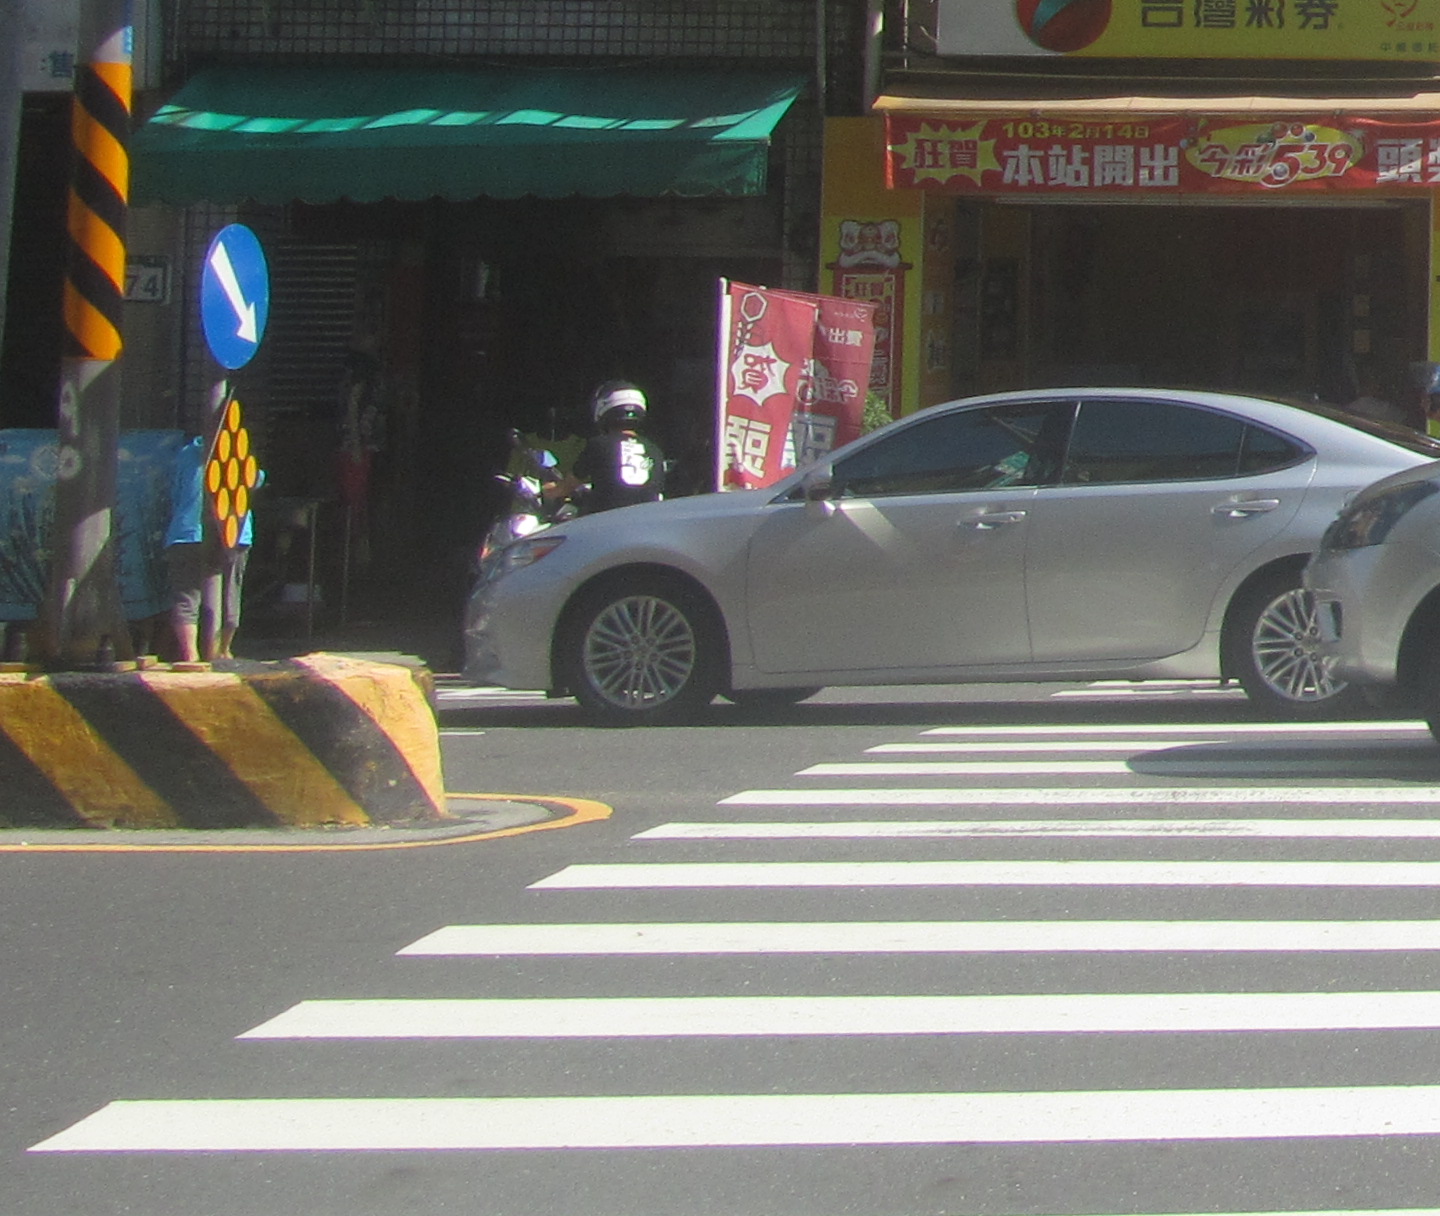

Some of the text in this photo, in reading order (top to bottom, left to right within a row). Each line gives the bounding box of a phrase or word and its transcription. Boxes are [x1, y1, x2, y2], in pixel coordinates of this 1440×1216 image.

[1001, 119, 1151, 141] 103年2月14日
[914, 136, 979, 171] 狂賀
[1001, 143, 1180, 188] 本站開出
[1197, 138, 1354, 189] 今彩539
